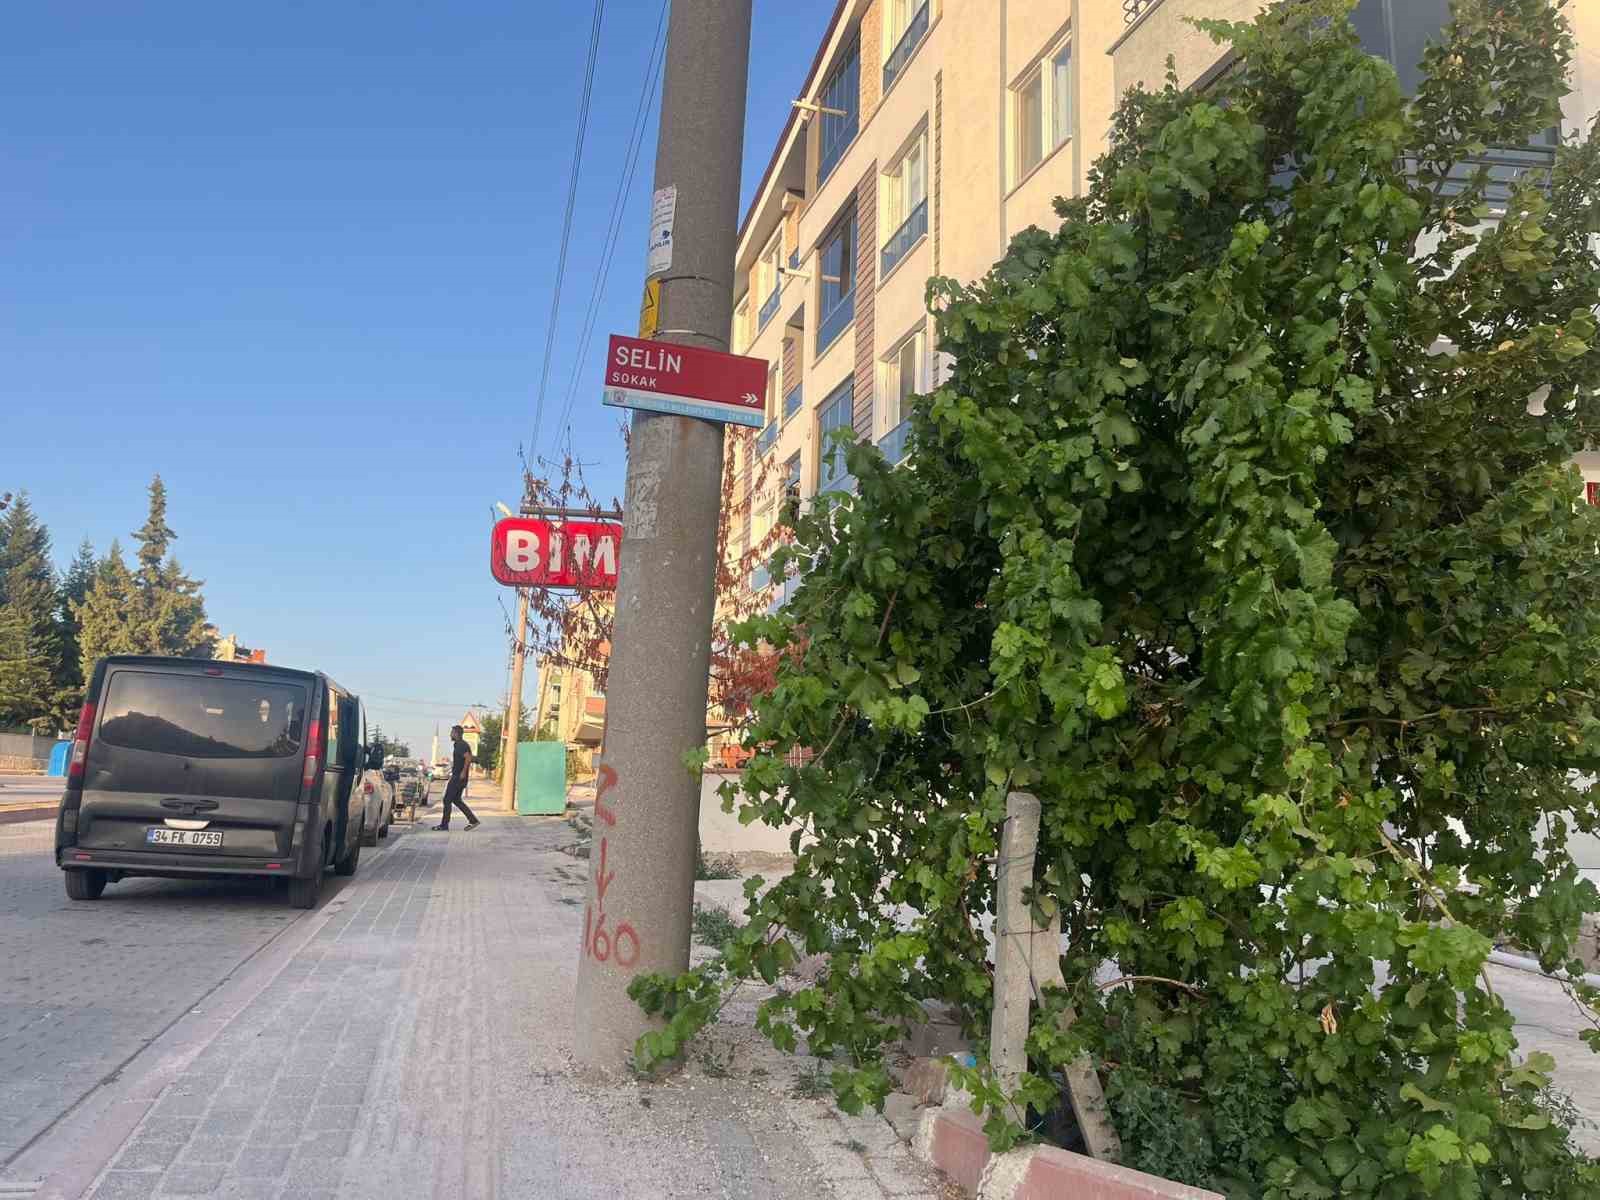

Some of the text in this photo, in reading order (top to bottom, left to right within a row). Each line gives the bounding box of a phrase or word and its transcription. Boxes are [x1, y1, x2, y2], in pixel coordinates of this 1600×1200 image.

[615, 345, 682, 374] SELİN
[611, 371, 657, 388] SOKAK
[154, 830, 221, 845] 34 FK 0759
[584, 903, 640, 967] 160
